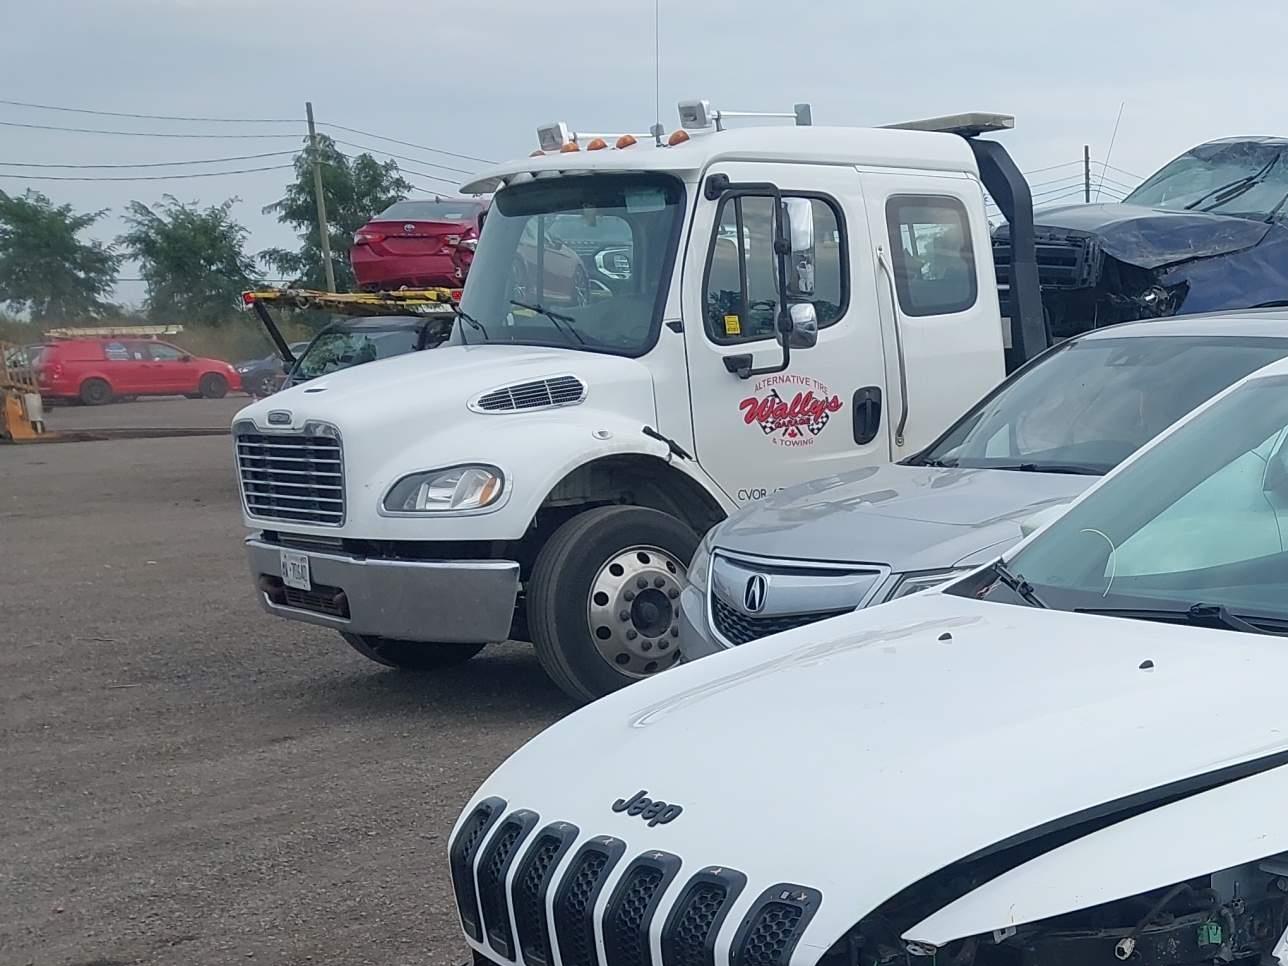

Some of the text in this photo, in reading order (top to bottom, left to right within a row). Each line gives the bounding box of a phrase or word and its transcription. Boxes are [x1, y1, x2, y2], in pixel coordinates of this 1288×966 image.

[754, 375, 811, 393] ALTERNATIVE
[780, 438, 814, 447] TOWING
[737, 488, 767, 501] CVOR
[611, 789, 684, 828] Jeep
